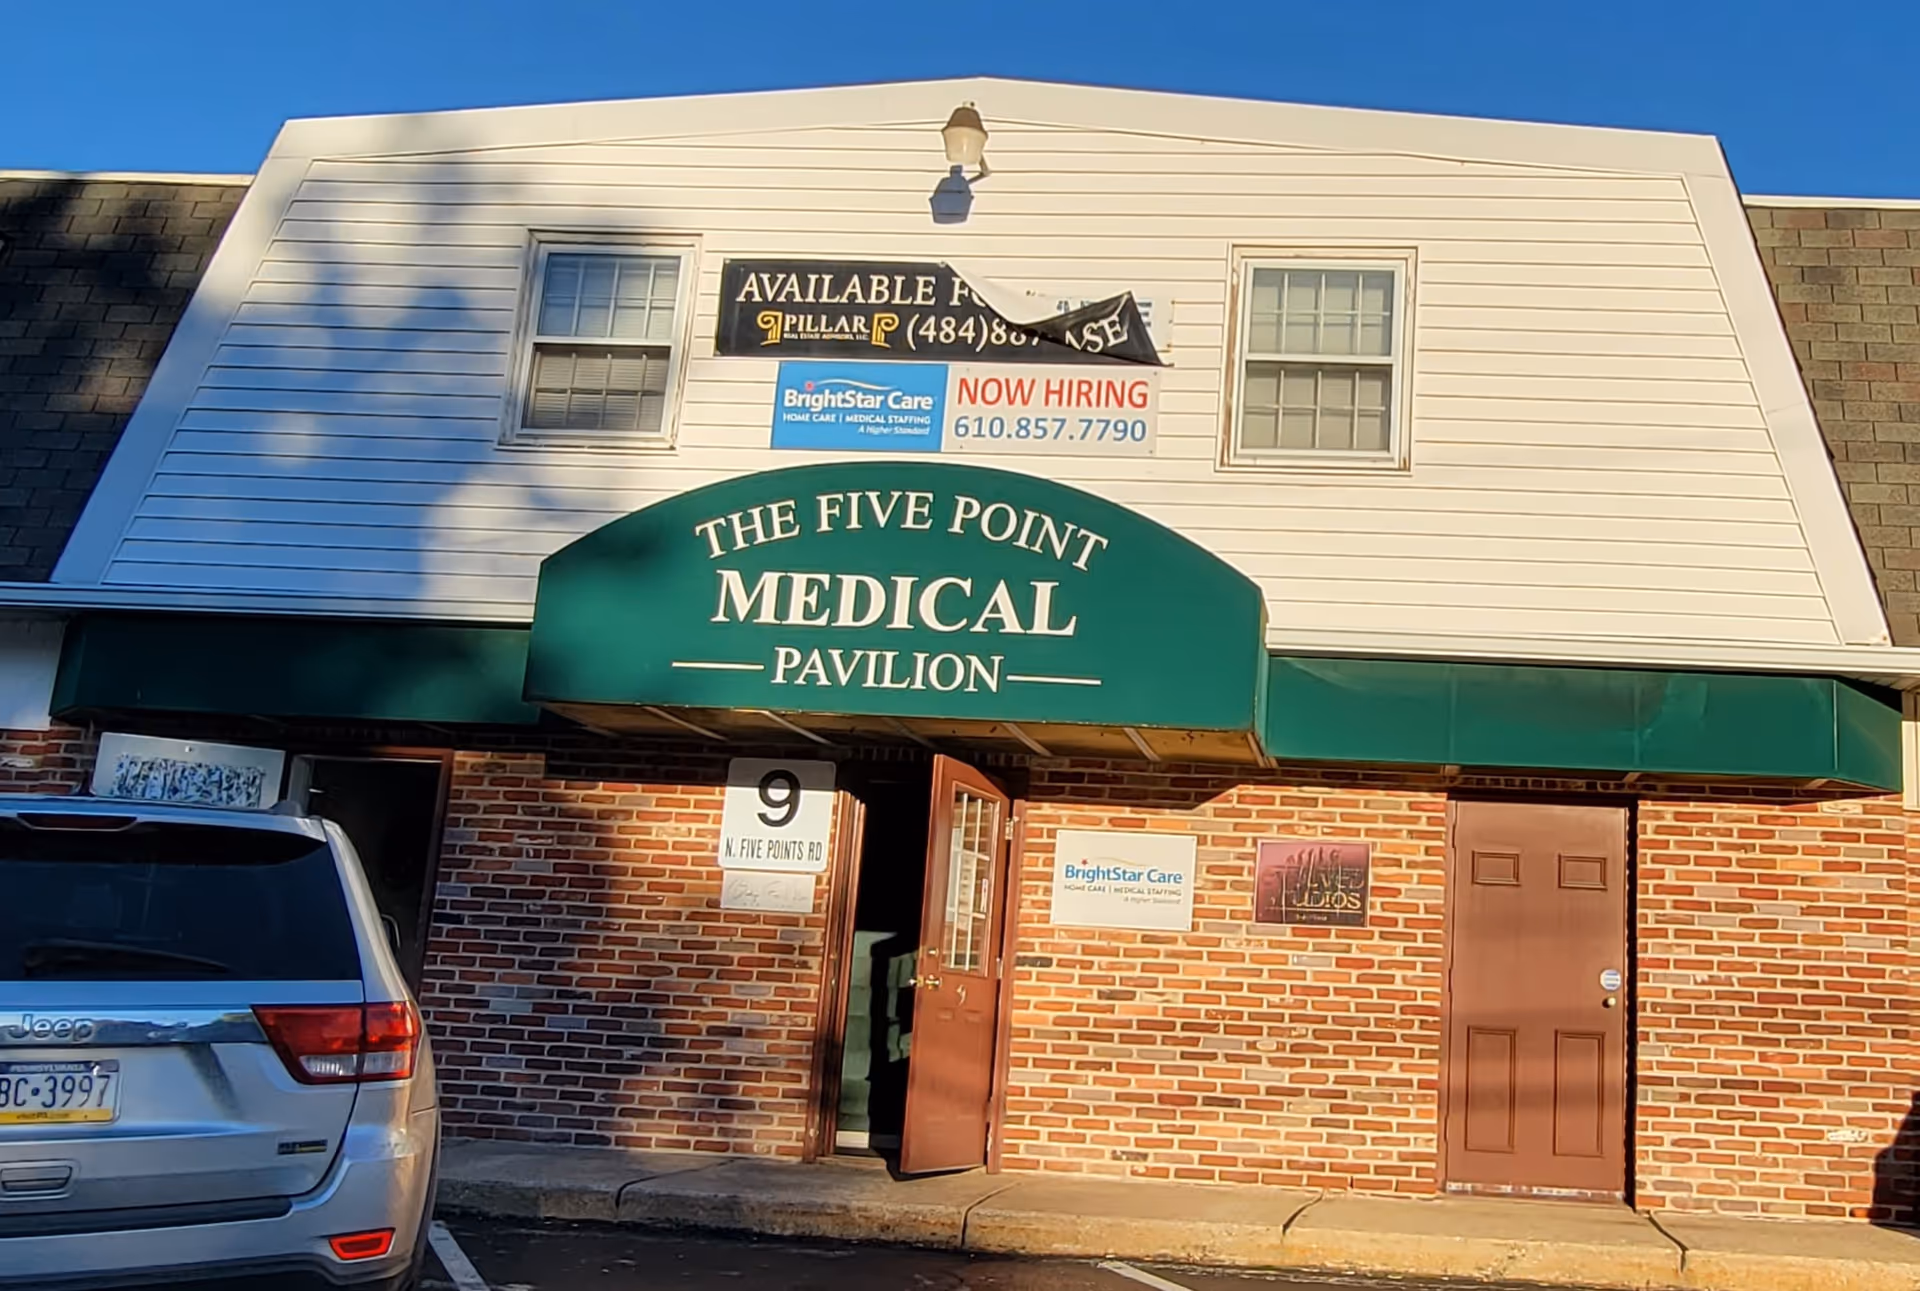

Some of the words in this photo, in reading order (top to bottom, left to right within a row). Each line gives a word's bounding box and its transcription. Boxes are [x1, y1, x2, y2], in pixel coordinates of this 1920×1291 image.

[735, 272, 937, 305] AVAILABLE
[783, 313, 871, 333] PILLAR
[783, 388, 885, 412] BrightStar
[887, 391, 934, 410] Care
[957, 377, 1036, 407] NOW
[1044, 378, 1149, 409] HIRING
[783, 412, 810, 422] HOME
[812, 413, 836, 423] CARE
[845, 413, 886, 424] MEDICAL
[888, 415, 931, 425] STAFFING
[954, 415, 1147, 442] 610.857.7790
[695, 499, 801, 559] THE
[816, 490, 935, 533] FIVE
[947, 494, 1109, 572] POINT
[710, 568, 1078, 636] MEDICAL
[771, 646, 1004, 693] PAVILION
[757, 769, 801, 828] 9
[725, 837, 736, 858] N.
[740, 838, 763, 859] FIVE
[767, 839, 804, 861] POINTS
[808, 841, 822, 861] RD
[1064, 864, 1144, 884] BrightStar
[1146, 868, 1183, 885] Care
[8, 1013, 94, 1042] Jeep
